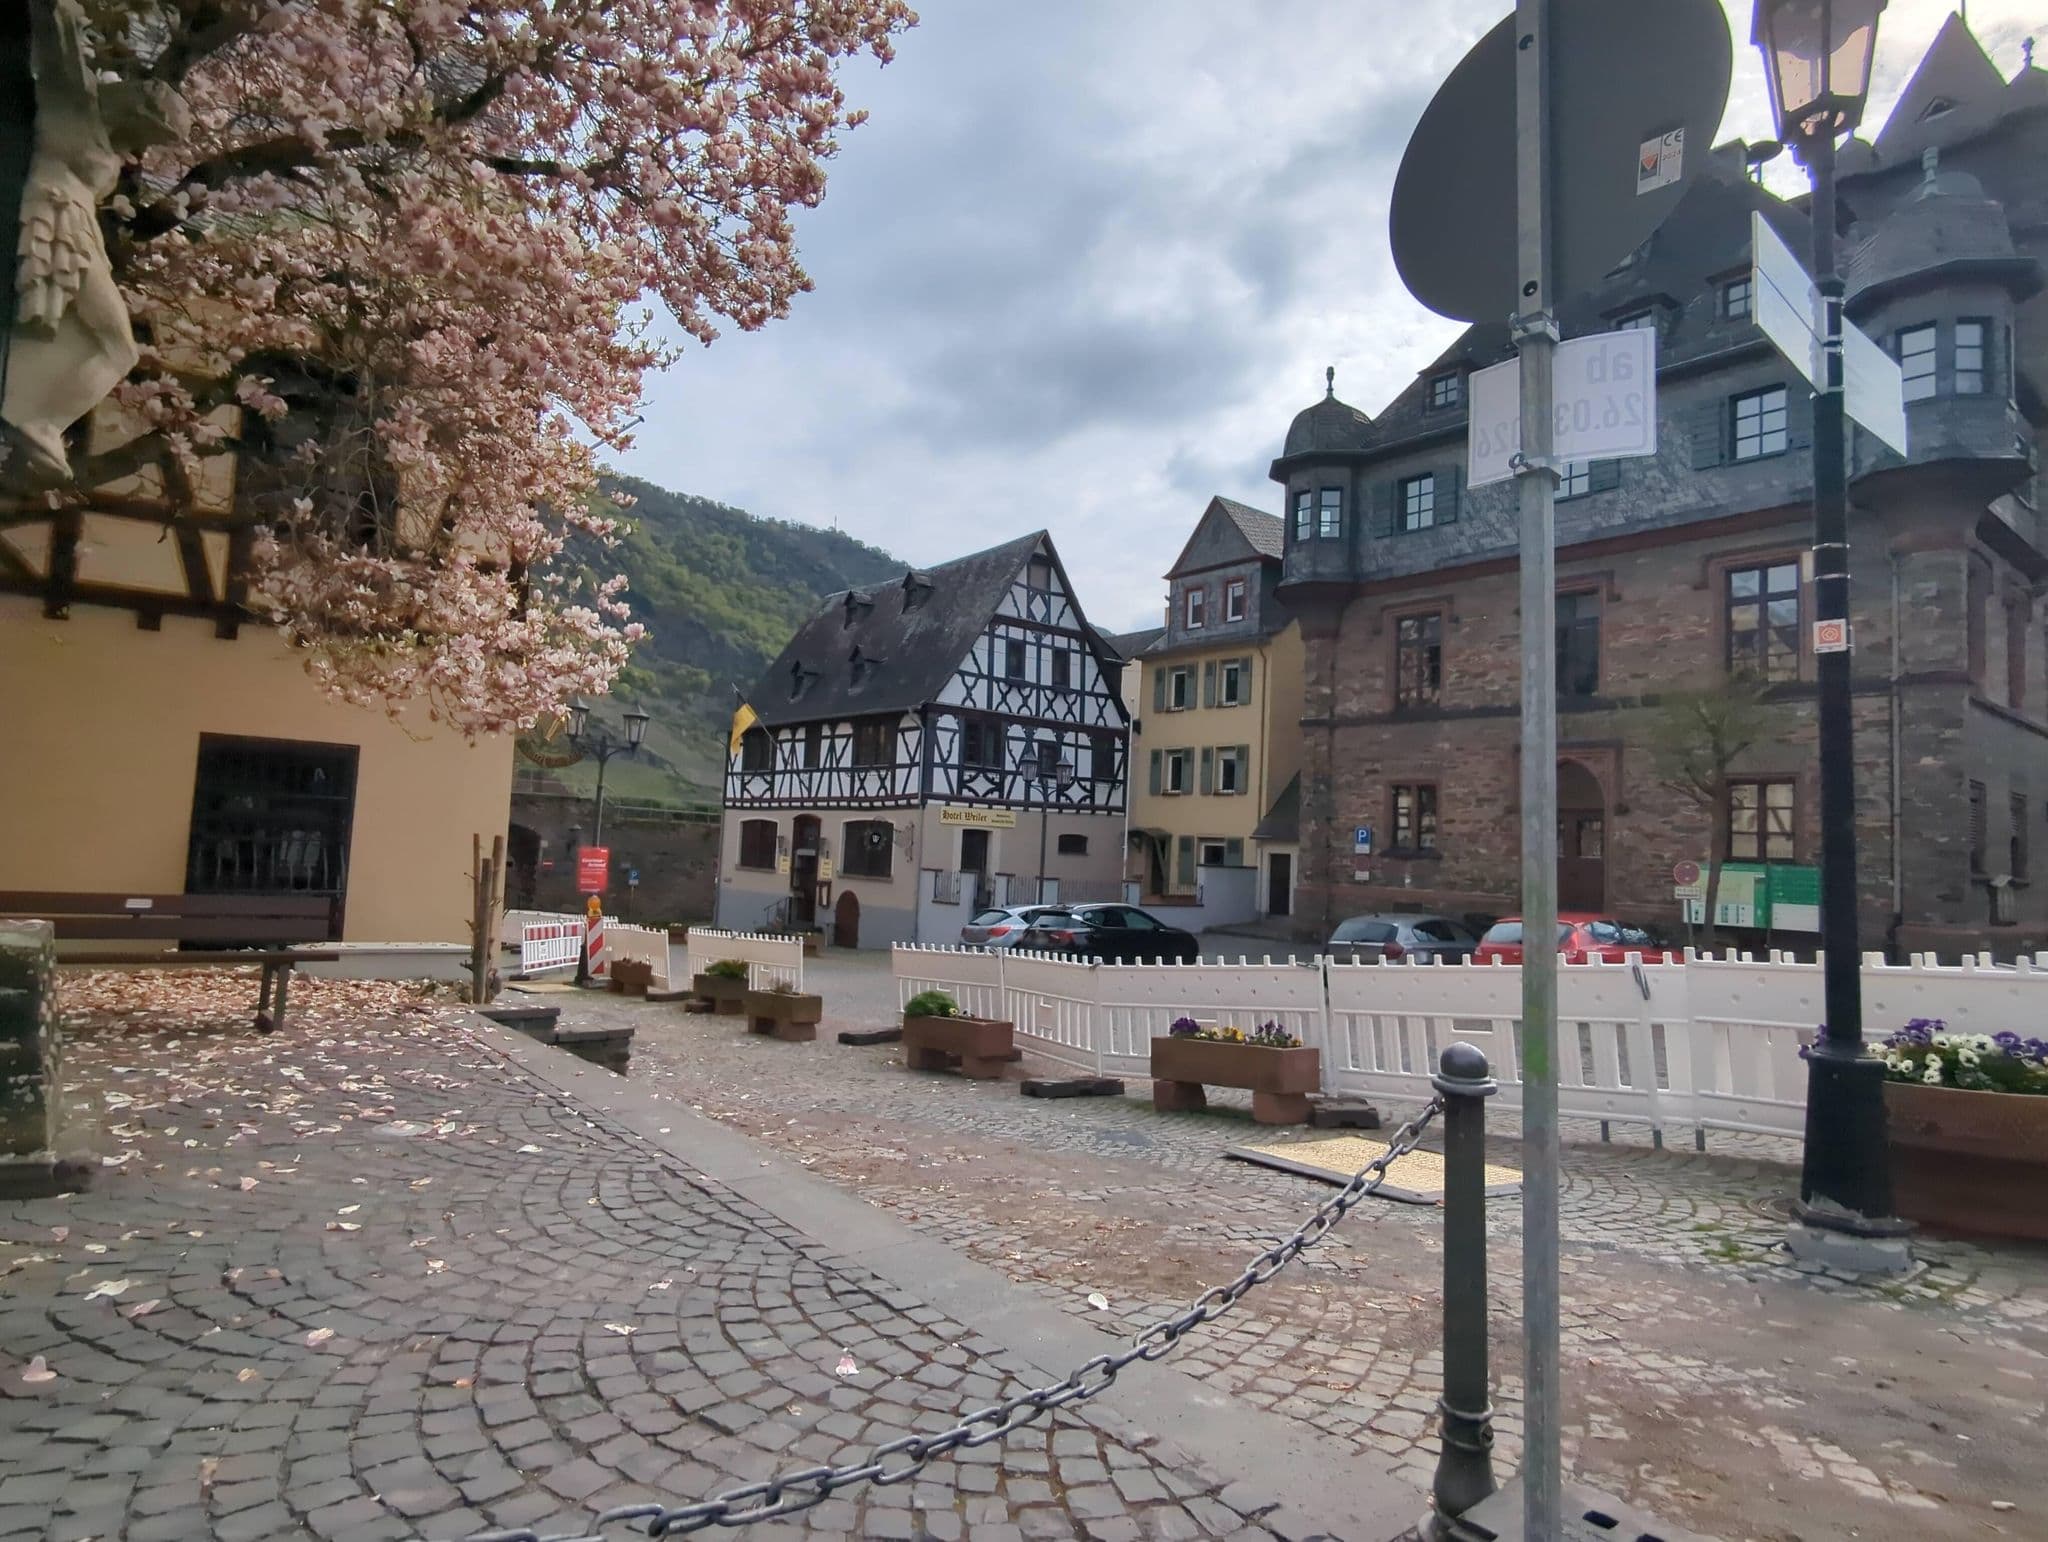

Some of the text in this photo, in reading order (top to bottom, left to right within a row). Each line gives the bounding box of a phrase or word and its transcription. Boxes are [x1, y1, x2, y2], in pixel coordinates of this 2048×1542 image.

[942, 809, 962, 820] Hotel
[964, 811, 988, 823] Weiler
[1358, 829, 1367, 843] P
